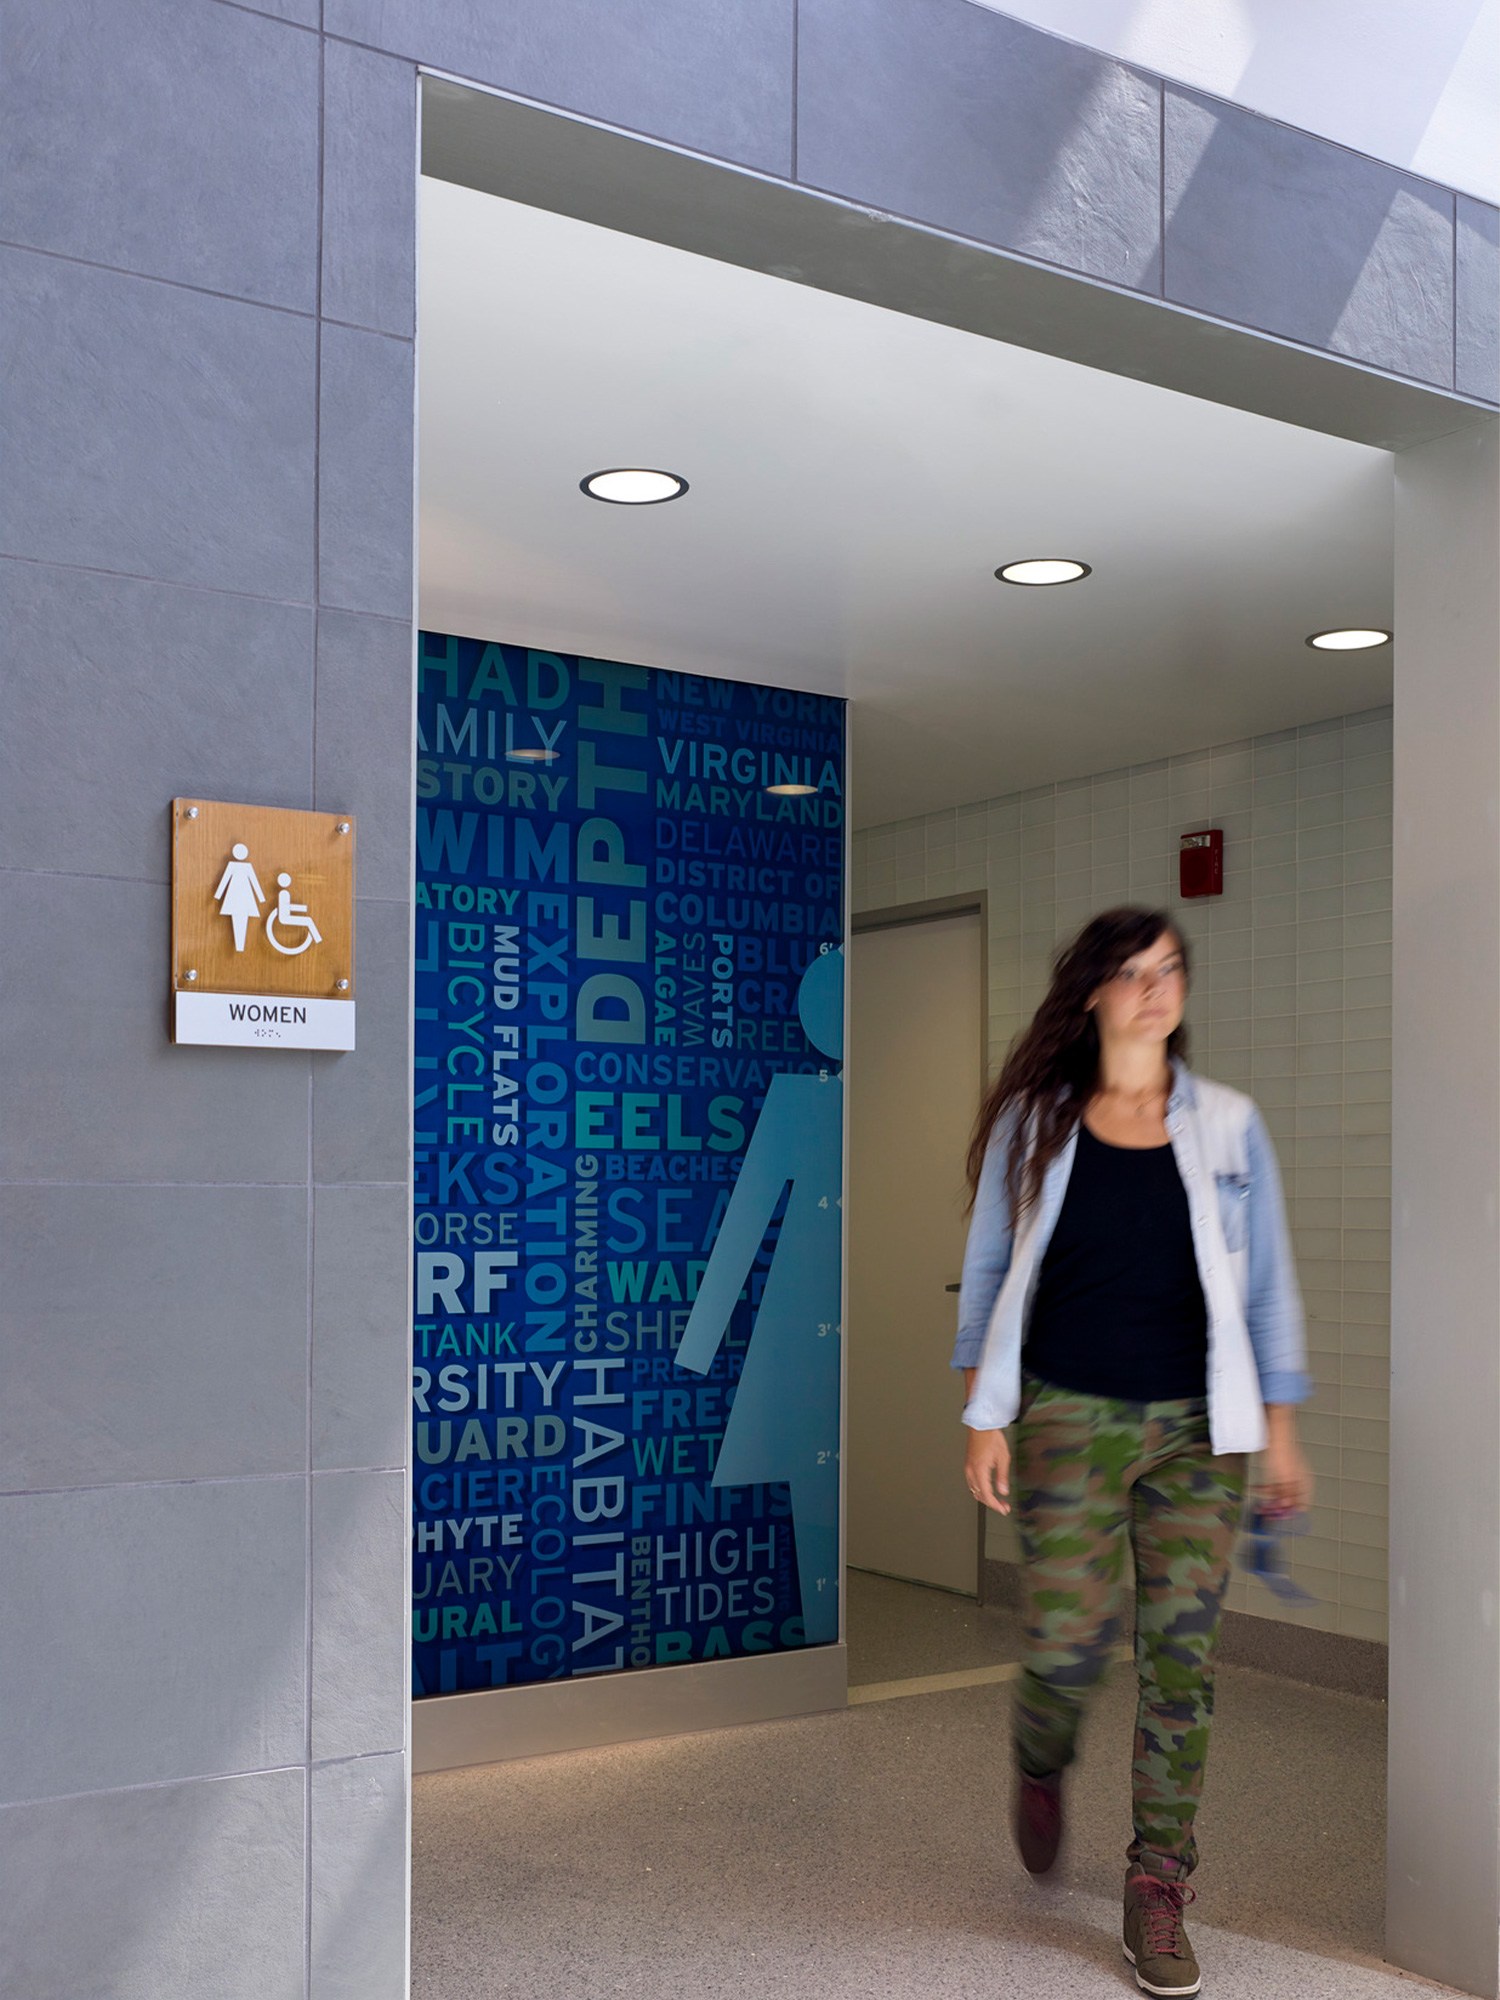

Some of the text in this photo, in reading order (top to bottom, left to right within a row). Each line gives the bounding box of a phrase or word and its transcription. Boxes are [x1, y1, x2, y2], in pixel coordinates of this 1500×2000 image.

[657, 671, 841, 725] NEW YORK
[657, 708, 840, 754] WEST VIRGINIA
[416, 759, 569, 812] STORY
[657, 736, 841, 796] VIRGINIA
[656, 778, 842, 829] MARYLAND
[576, 657, 650, 1046] DEPTH
[656, 817, 841, 868] DELAWARE
[656, 856, 841, 899] DISTRICT OF
[655, 891, 841, 936] COLUMBIA
[229, 1003, 307, 1024] WOMEN
[654, 930, 676, 1047] ALGAE
[682, 932, 705, 1047] WAVES
[711, 933, 733, 1048] PORTS
[448, 921, 485, 1144] BICYCLE
[492, 925, 520, 1146] MUD FLATS
[737, 1018, 810, 1053] REE
[525, 891, 568, 1352] EXPLORATION
[575, 1090, 746, 1152] EELS
[414, 1212, 519, 1245] ORSE
[574, 1153, 599, 1353] CHARMING
[417, 1251, 519, 1315] RF
[414, 1322, 518, 1358] TANK
[417, 1414, 566, 1464] UARD
[412, 1468, 526, 1512] CIER
[572, 1357, 625, 1675] HABITAT
[412, 1513, 523, 1553] HYTE
[656, 1525, 775, 1581] HIGH
[530, 1464, 566, 1680] ECOLOG
[630, 1536, 651, 1667] BENTHO
[656, 1576, 774, 1625] TIDES
[655, 1615, 806, 1664] BASS
